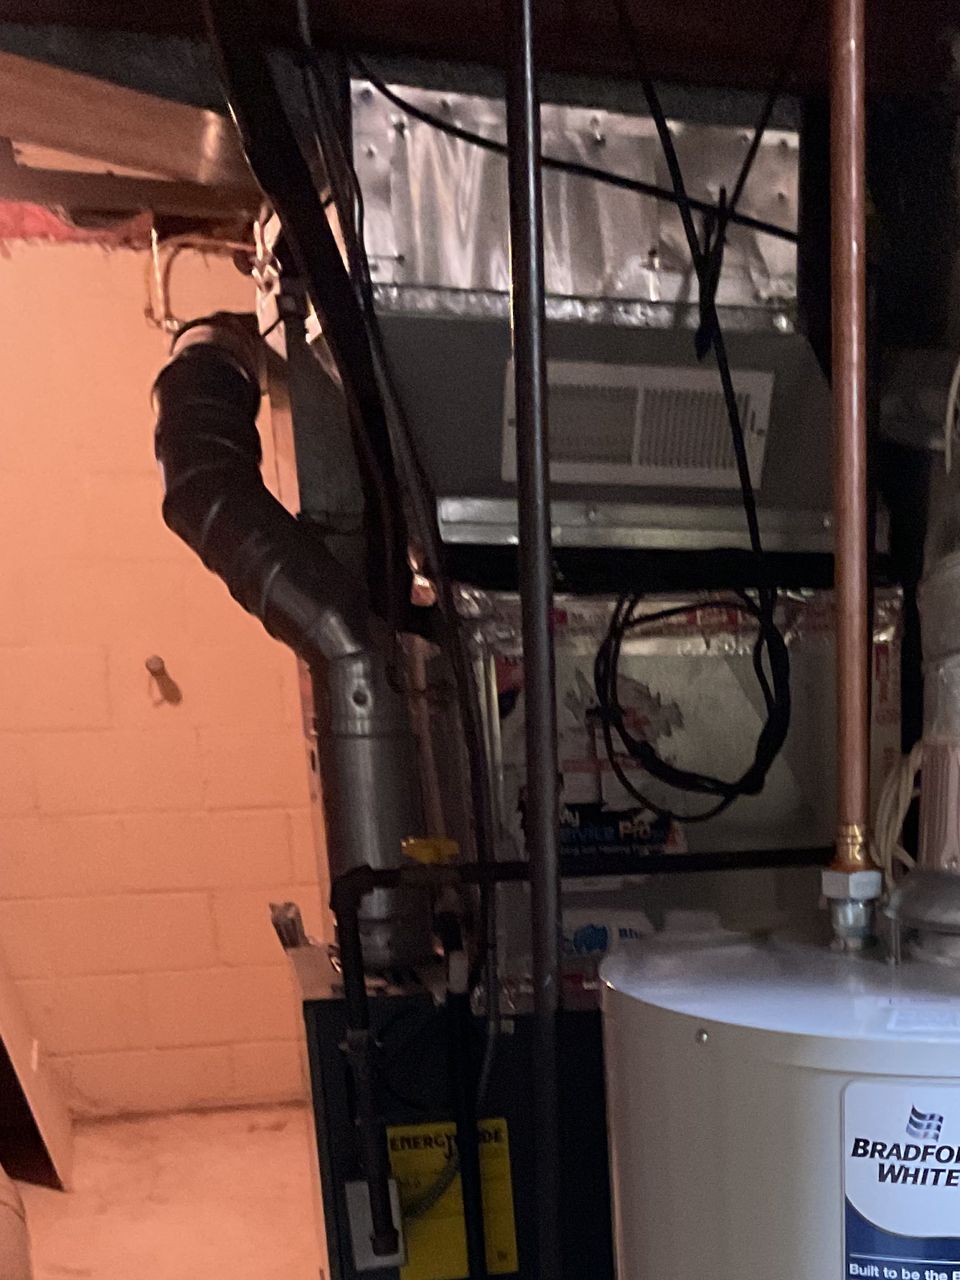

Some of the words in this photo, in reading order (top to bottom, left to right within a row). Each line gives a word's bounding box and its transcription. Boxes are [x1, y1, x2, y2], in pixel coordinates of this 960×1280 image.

[849, 1263, 879, 1278] Built
[883, 1266, 898, 1279] to
[901, 1268, 921, 1280] be
